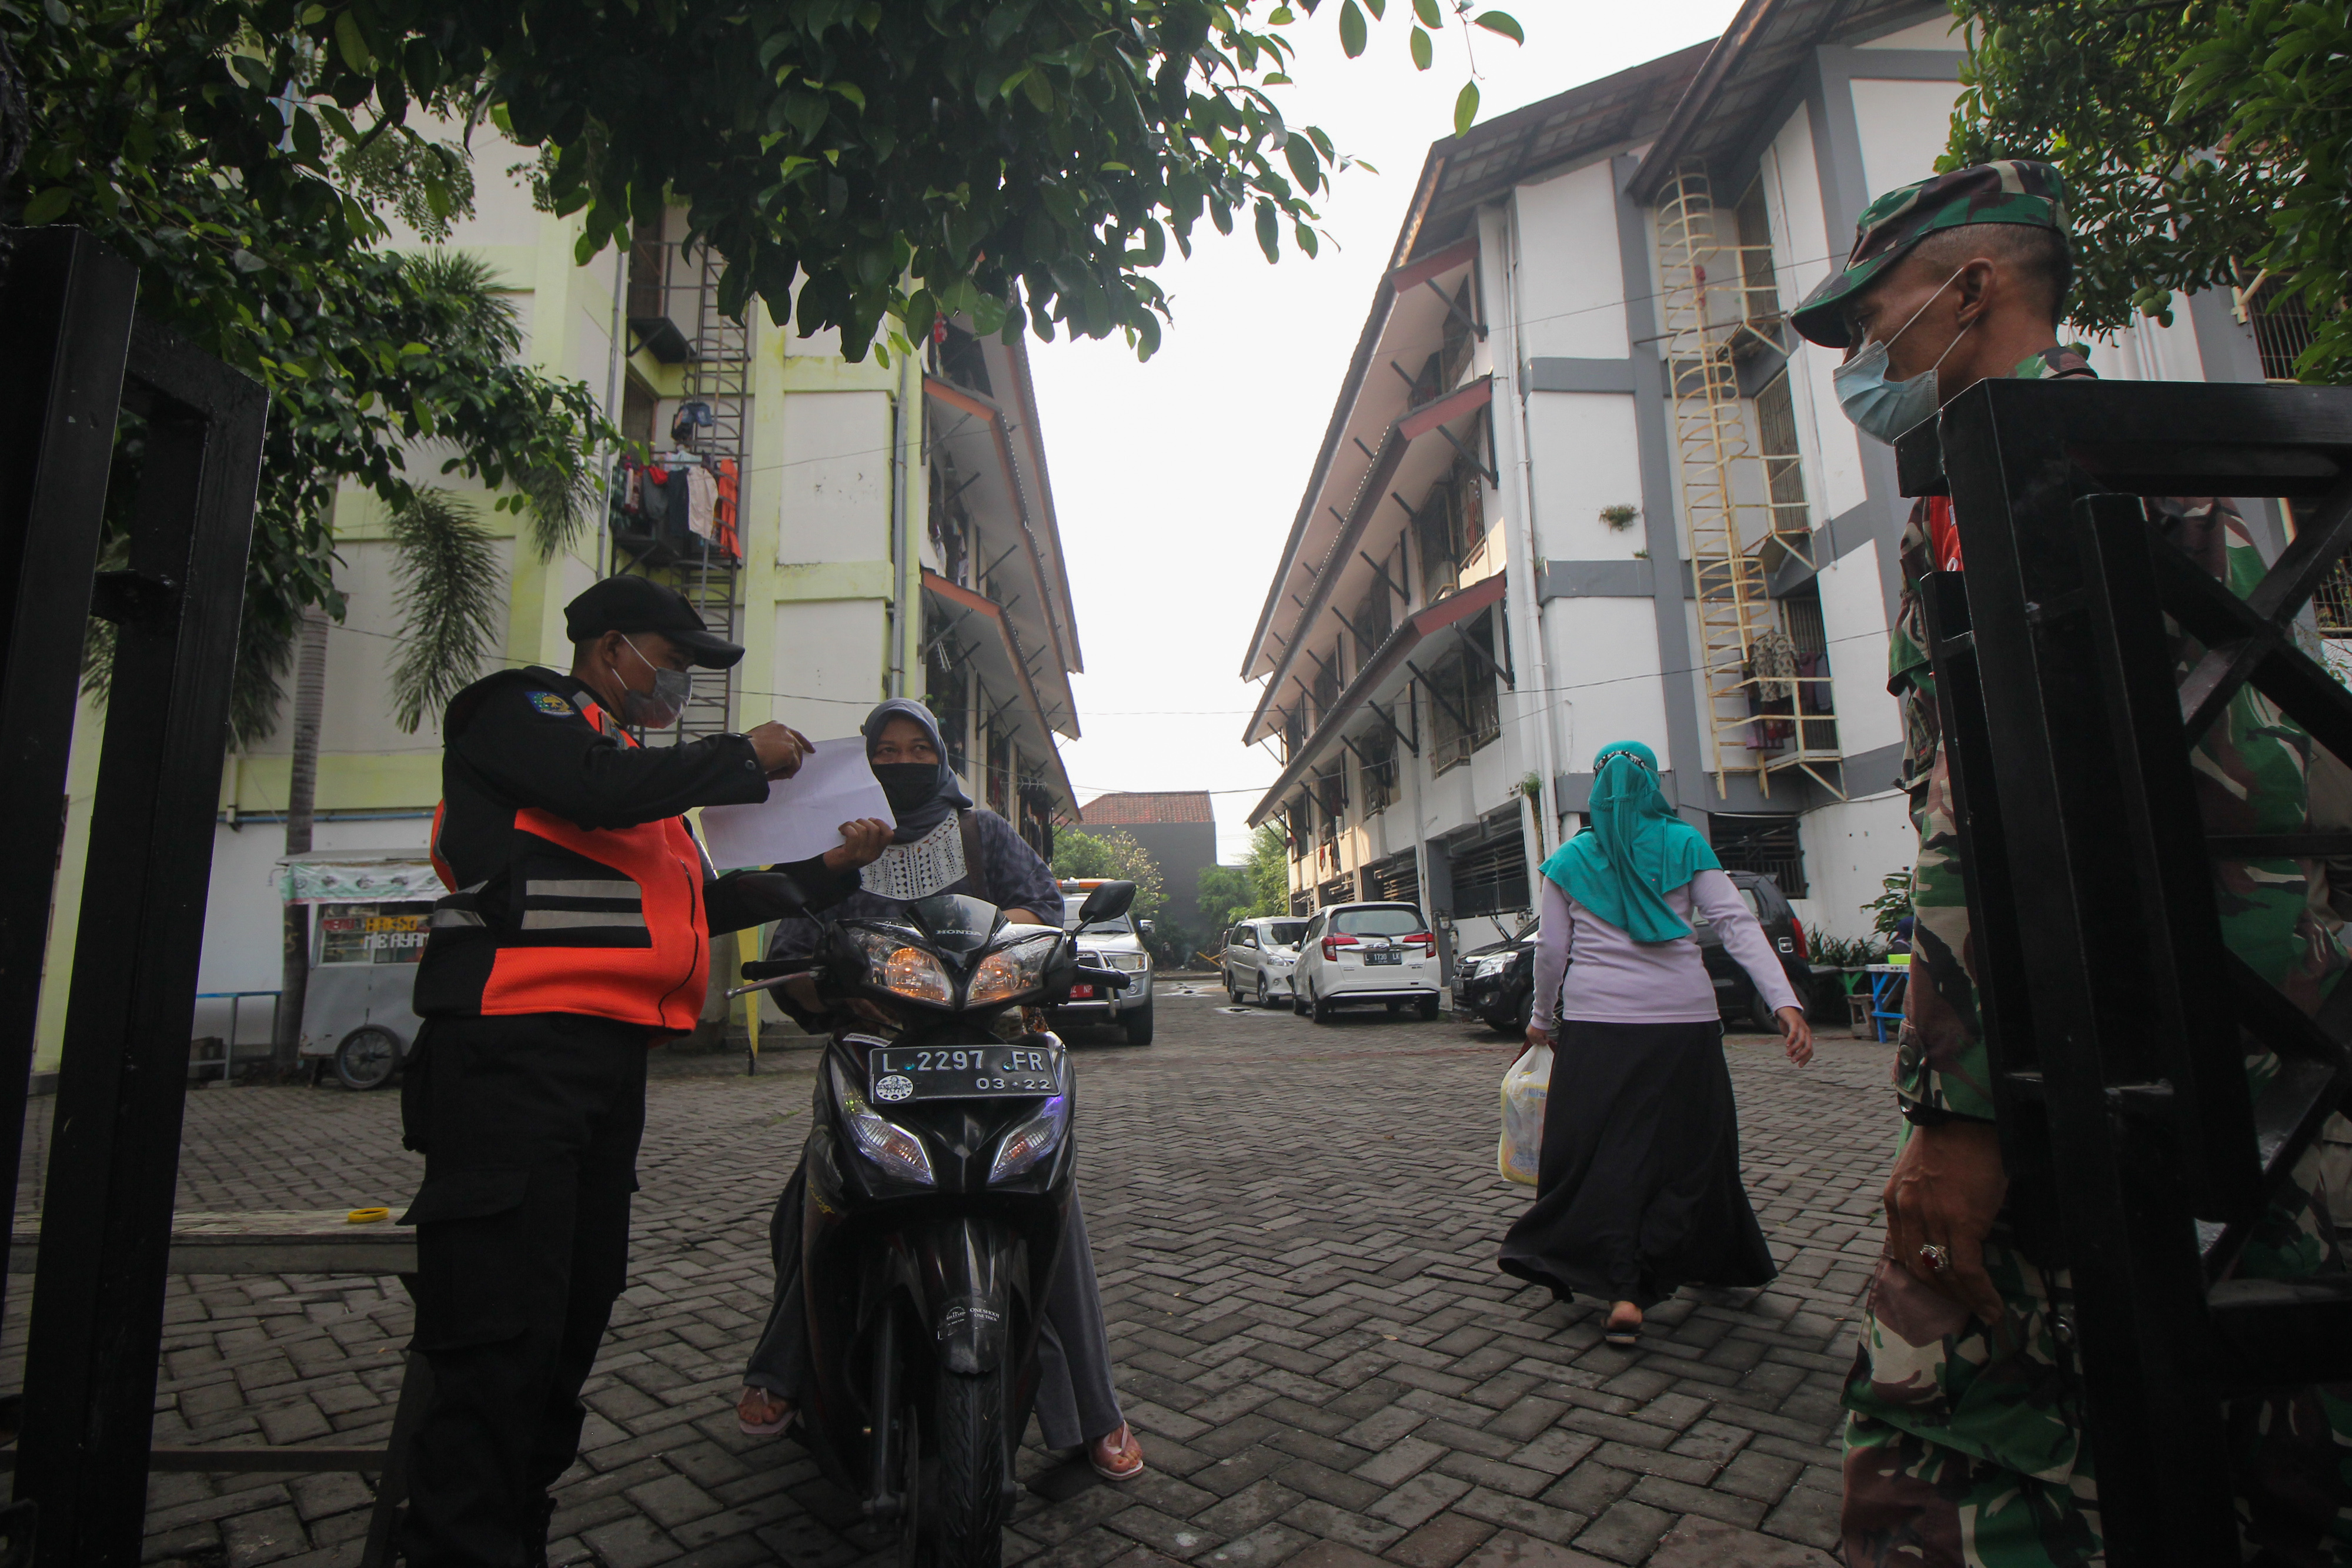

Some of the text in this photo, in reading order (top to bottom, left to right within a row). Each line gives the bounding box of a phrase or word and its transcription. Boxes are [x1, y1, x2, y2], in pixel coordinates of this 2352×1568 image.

[365, 916, 418, 932] BAKSO
[1084, 985, 1092, 993] NP
[883, 1050, 1044, 1072] L 2297 FR
